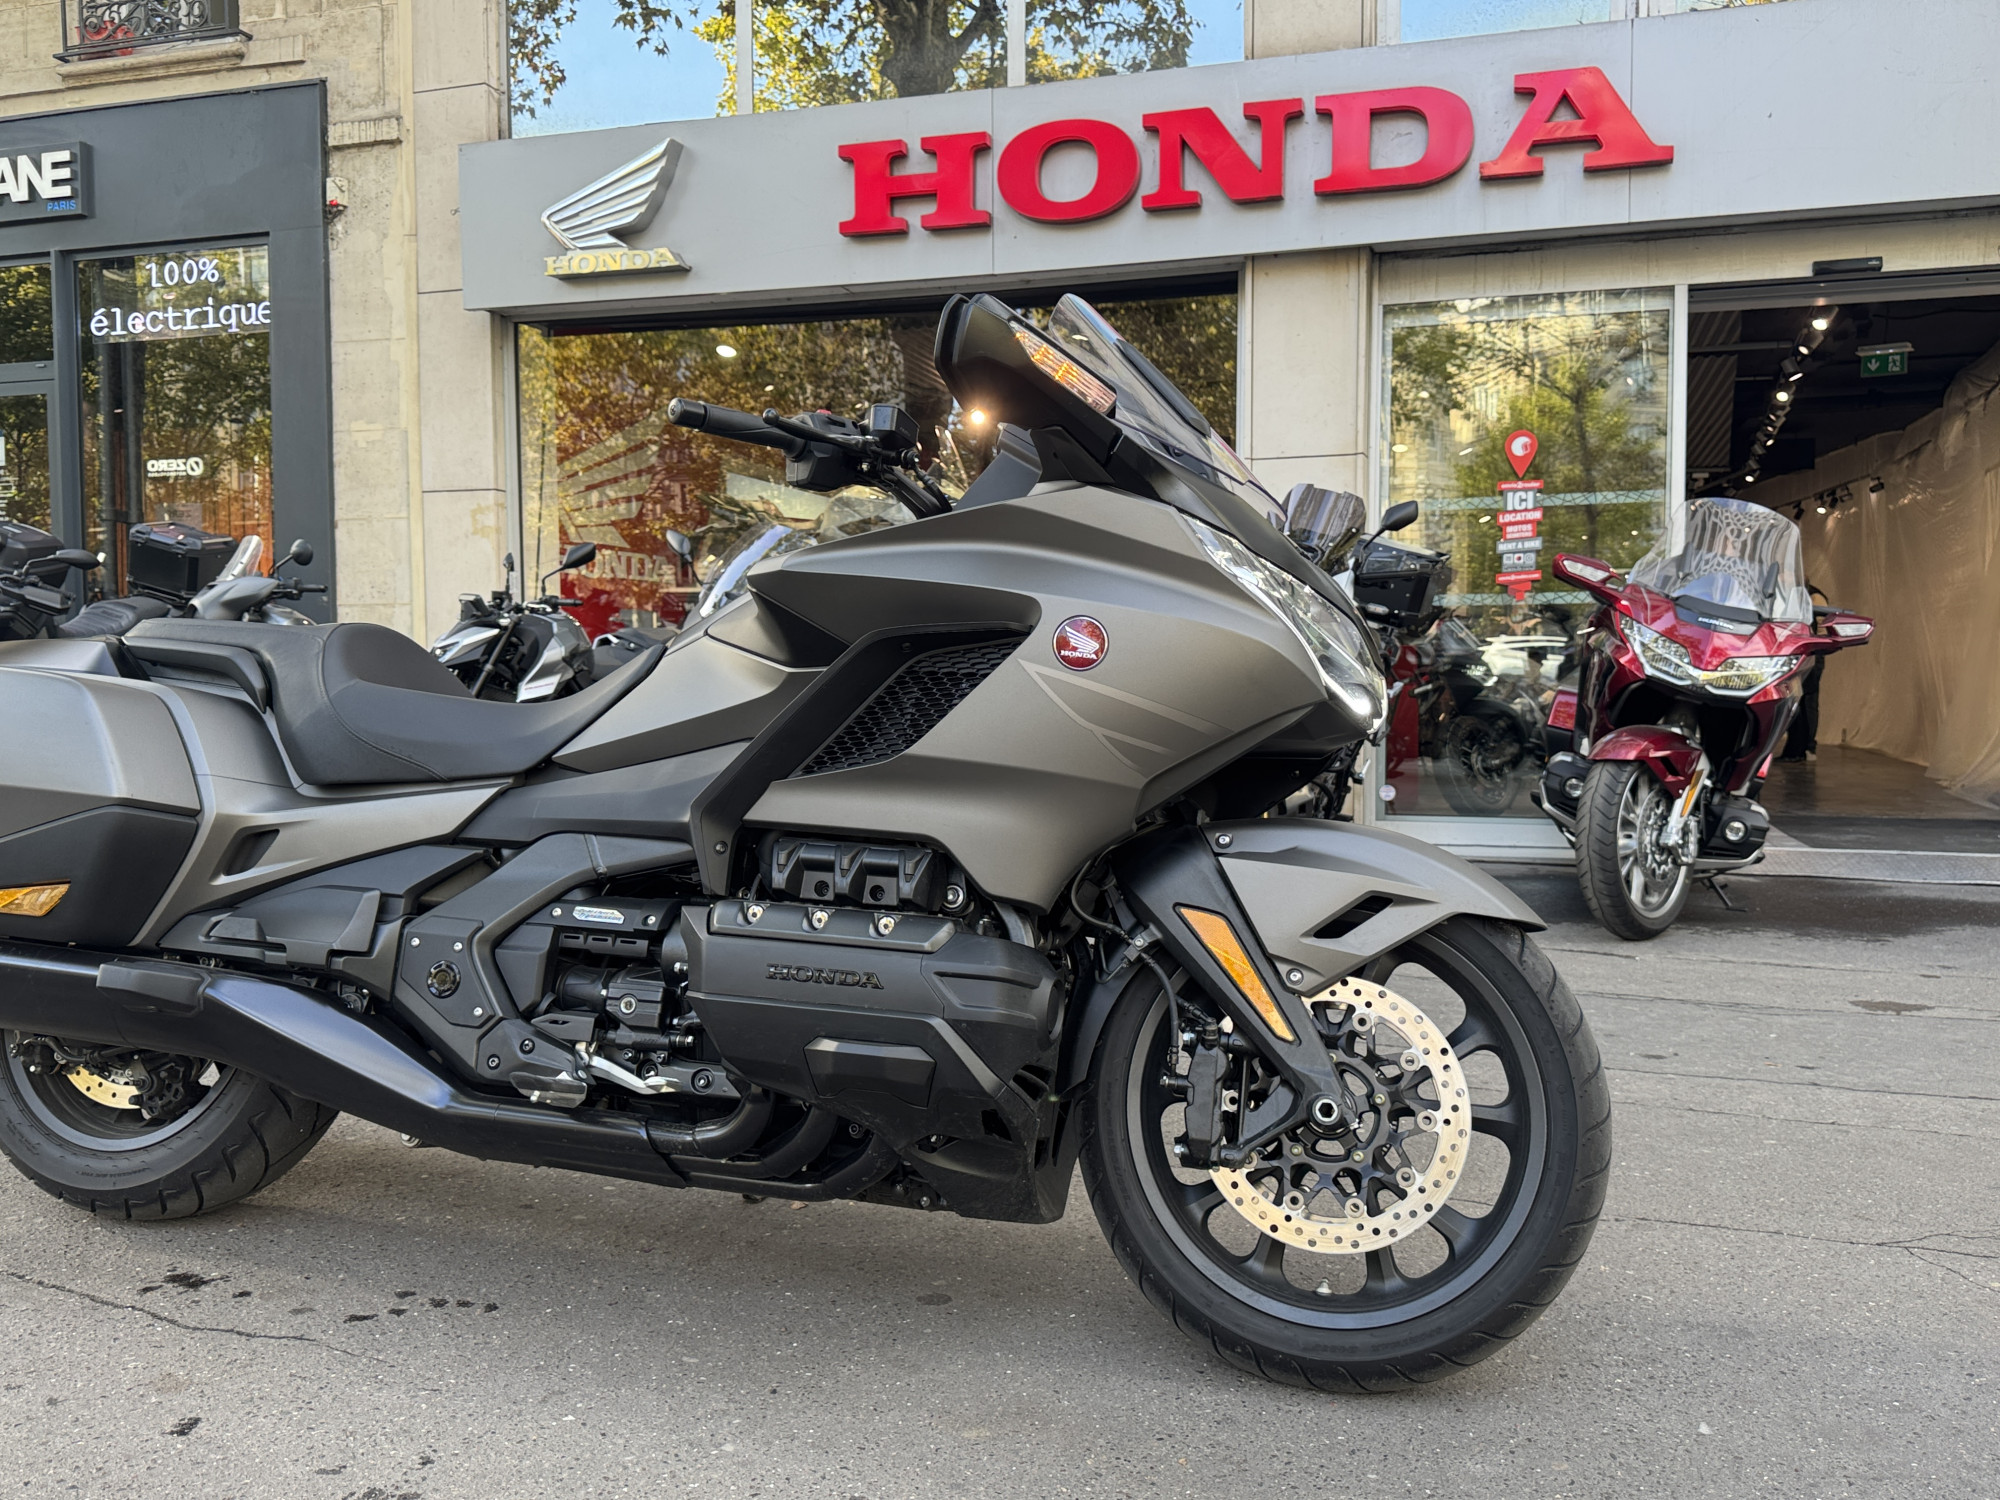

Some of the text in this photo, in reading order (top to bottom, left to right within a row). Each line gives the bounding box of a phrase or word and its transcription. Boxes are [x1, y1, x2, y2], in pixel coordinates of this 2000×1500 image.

[838, 66, 1674, 237] HONDA
[47, 200, 76, 211] PARIS
[544, 247, 678, 276] HONDA
[145, 257, 219, 288] 100%
[90, 297, 271, 336] électrique
[1507, 491, 1534, 510] ICI
[1499, 510, 1541, 522] LOCATION
[1506, 524, 1532, 532] MOTOS
[1498, 542, 1516, 550] RENT
[1524, 539, 1540, 548] BIKE
[1060, 650, 1097, 660] HONDA
[766, 963, 884, 990] HONDA
